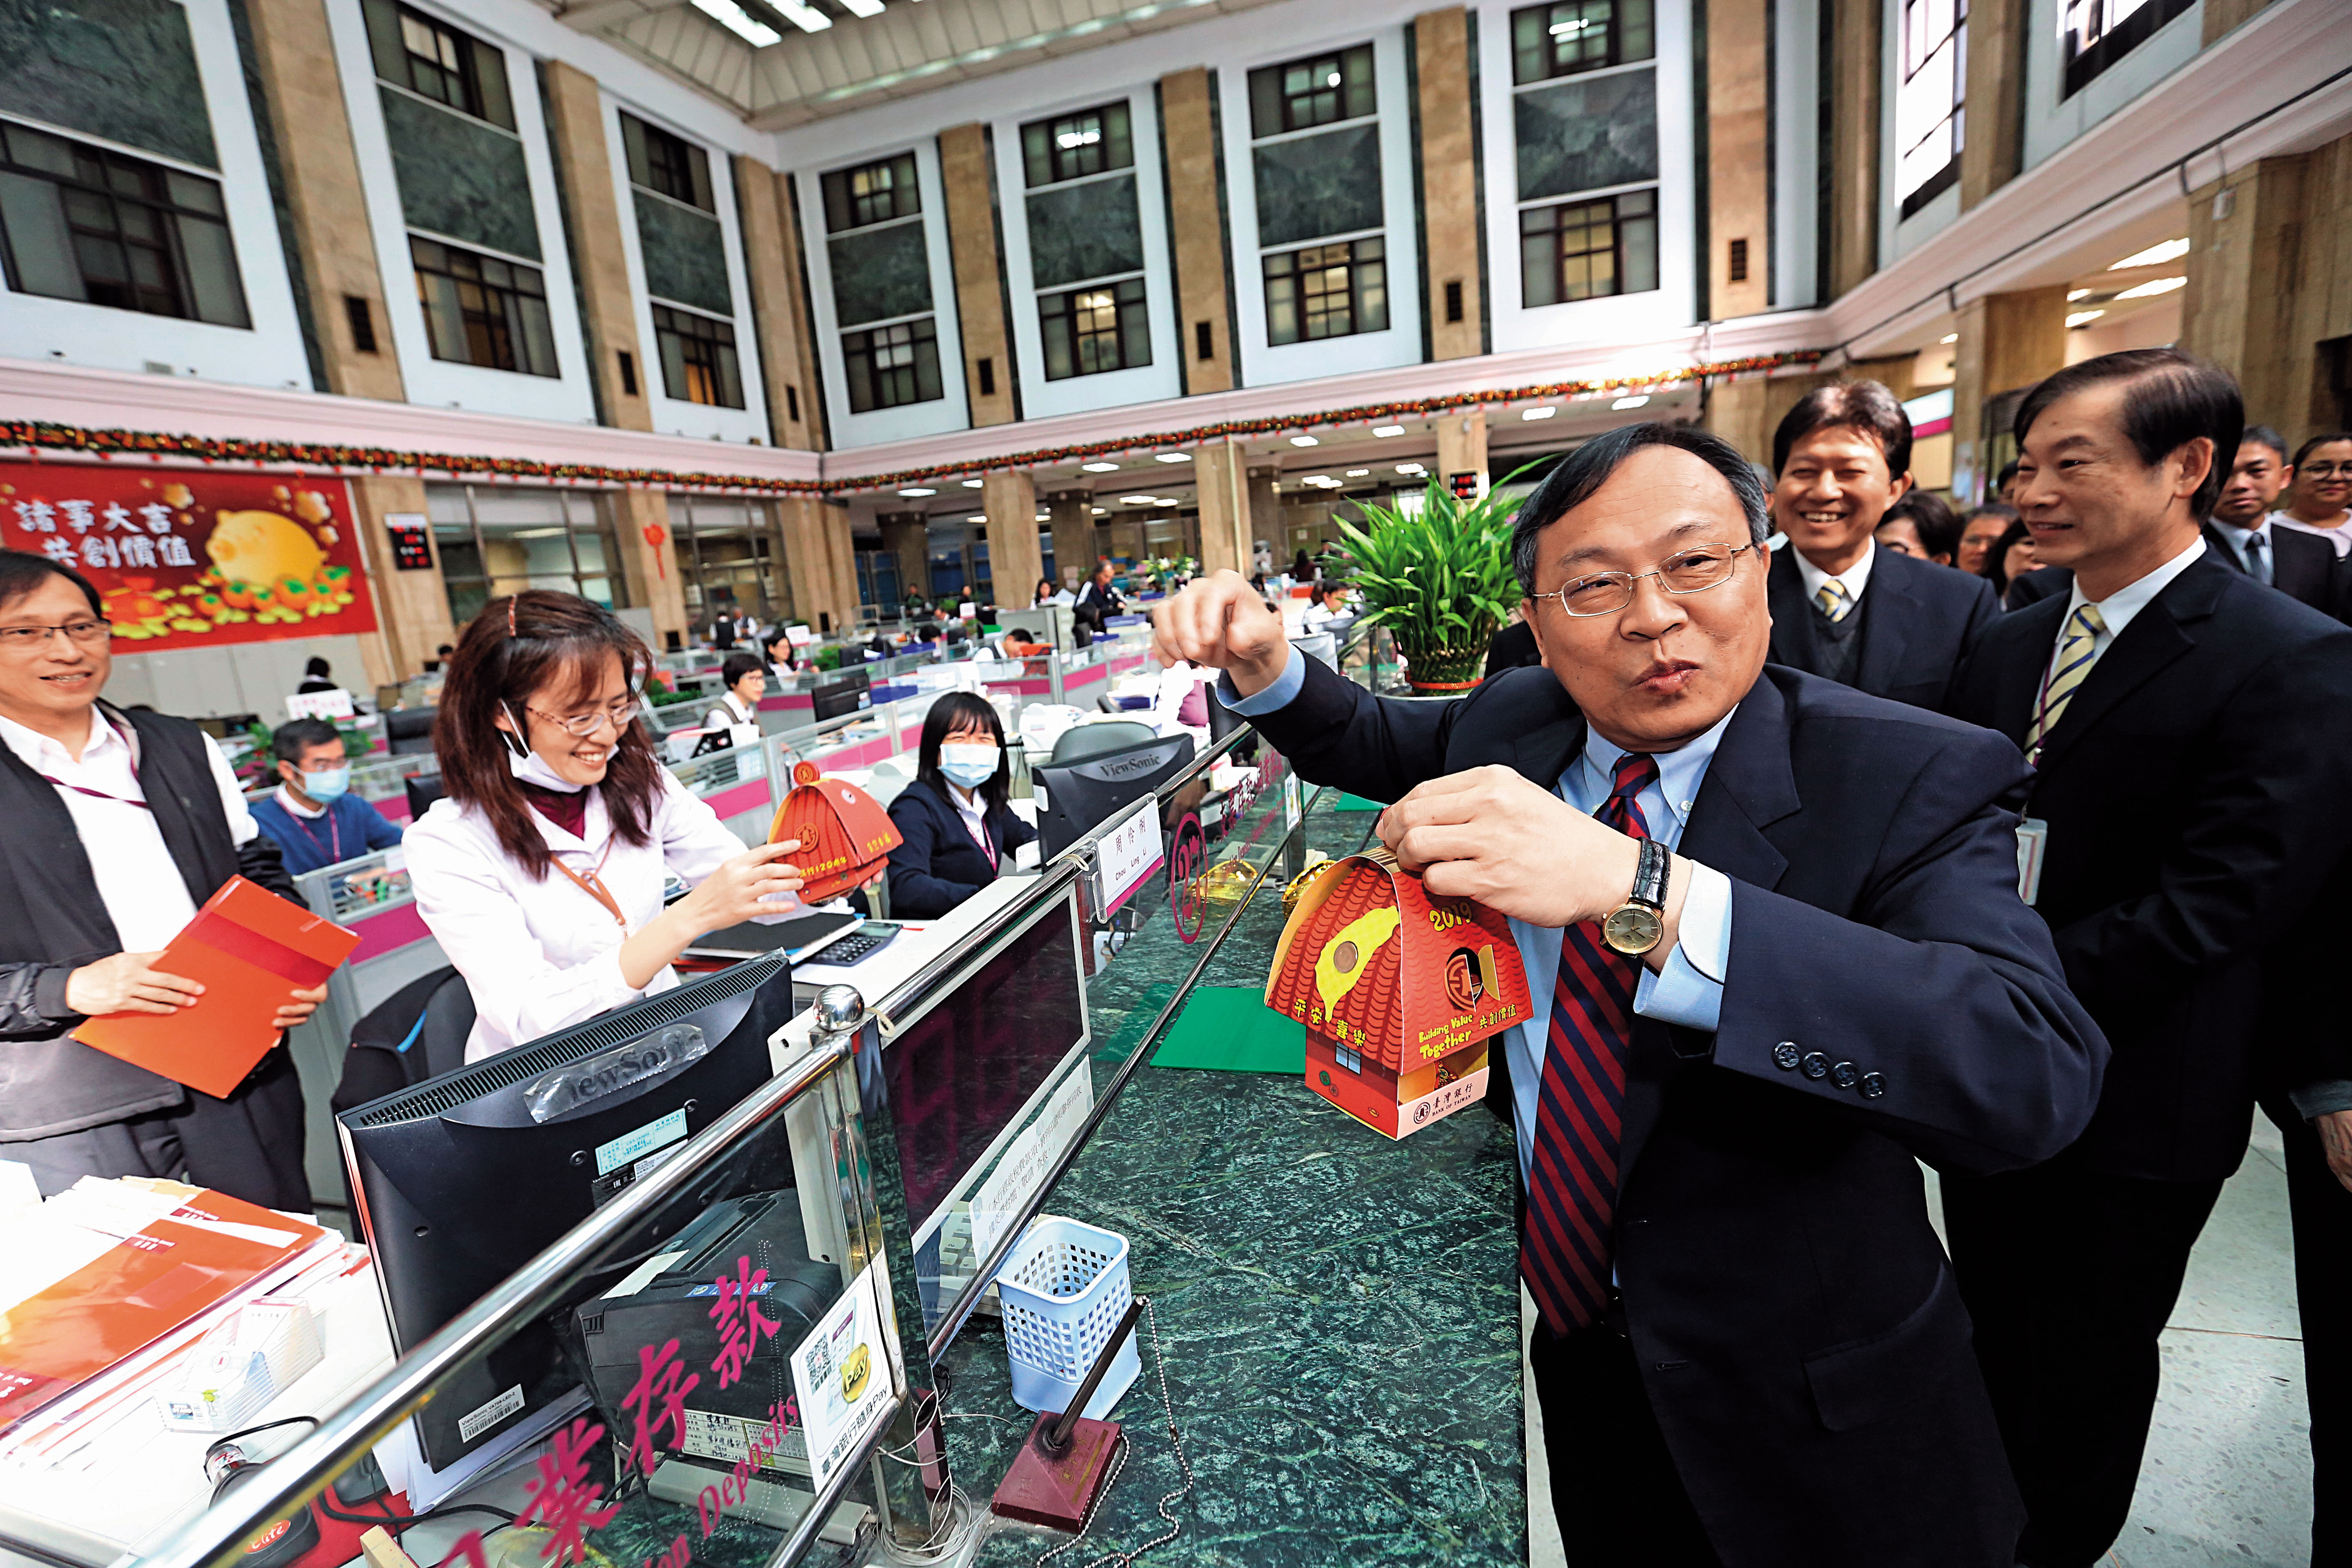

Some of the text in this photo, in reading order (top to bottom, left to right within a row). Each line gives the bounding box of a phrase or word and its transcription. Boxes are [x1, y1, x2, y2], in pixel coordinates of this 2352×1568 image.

[13, 499, 173, 535] 諸事大吉
[42, 535, 196, 569] 共創價值
[1100, 754, 1160, 777] ViewSonic
[1116, 846, 1147, 880] Chou Ling Li
[1429, 901, 1472, 931] 2019
[1294, 998, 1366, 1047] 平安喜樂
[1419, 1014, 1473, 1043] Building Value
[1479, 1003, 1517, 1030] 共創價值
[1419, 1030, 1472, 1060] Together
[1432, 1107, 1444, 1116] BANK
[1454, 1094, 1472, 1106] TAIWAN
[1433, 1083, 1473, 1109] 臺灣銀行
[844, 1354, 868, 1392] Pay
[461, 1408, 488, 1426] ViewSonic
[821, 1384, 889, 1479] 臺灣銀行隨身Pay
[697, 1394, 799, 1541] Deposits
